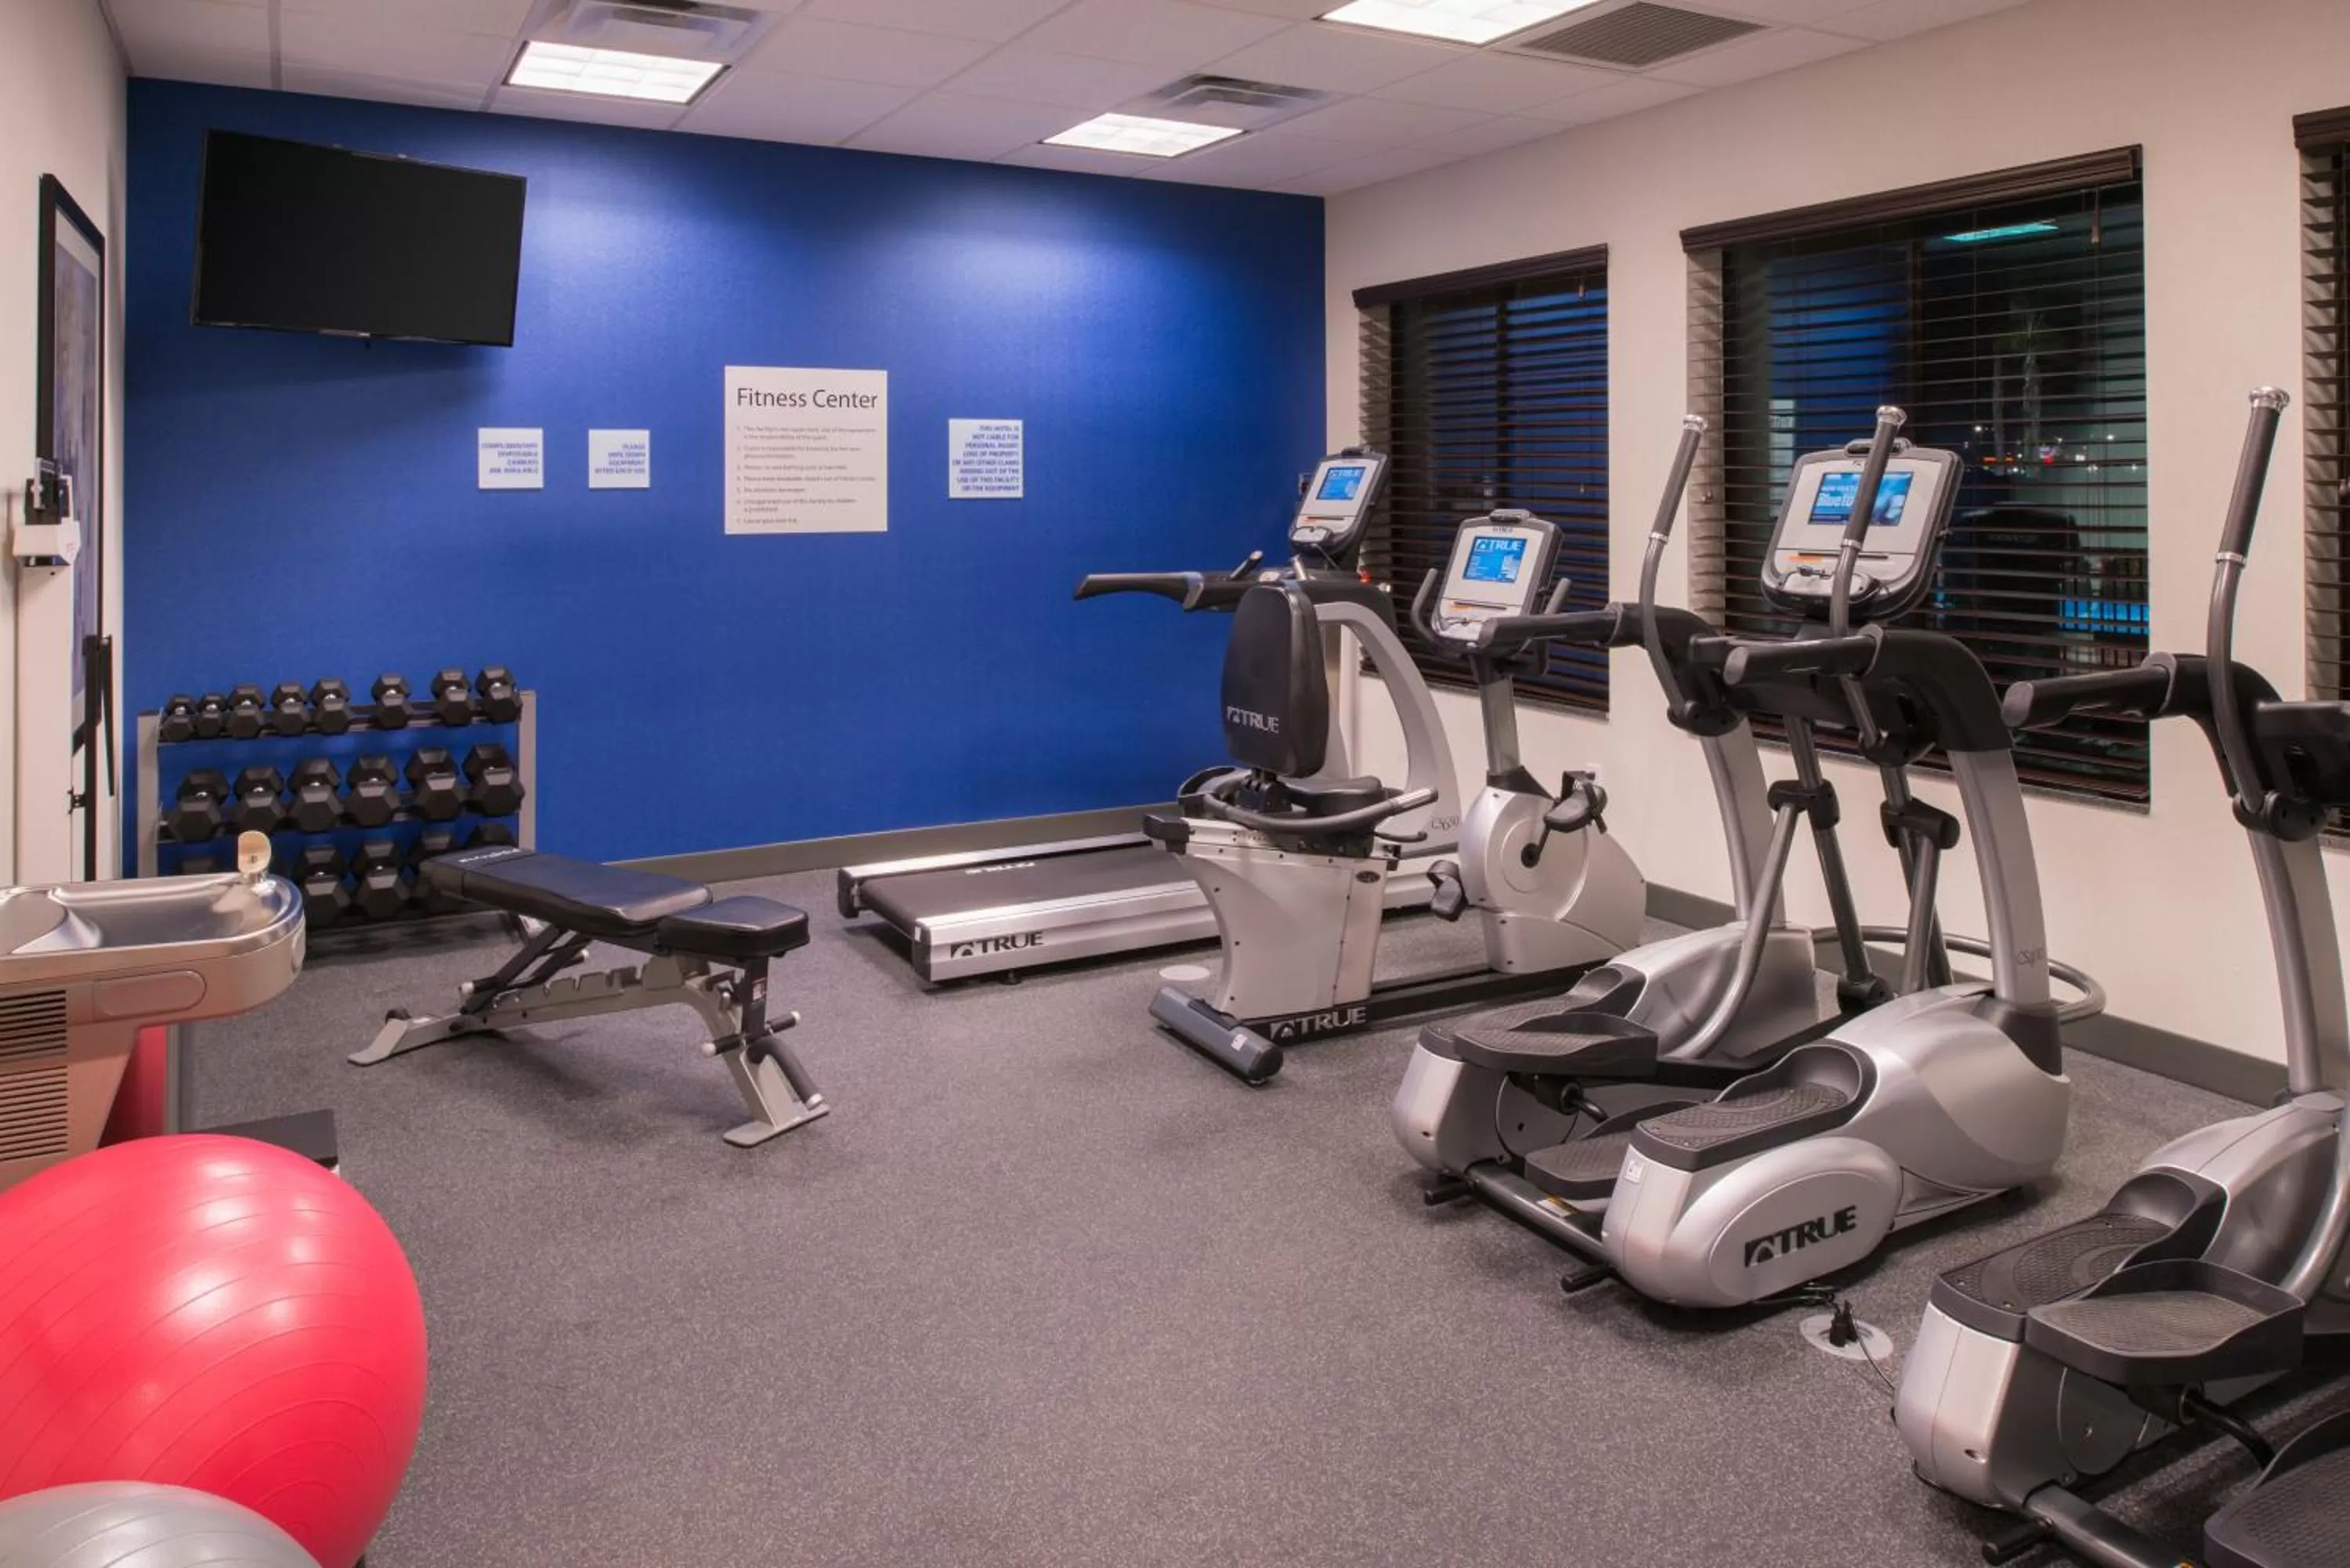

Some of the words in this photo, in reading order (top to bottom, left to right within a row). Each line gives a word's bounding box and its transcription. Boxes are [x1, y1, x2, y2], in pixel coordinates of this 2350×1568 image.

[737, 388, 807, 407] Fitness
[812, 388, 878, 409] Center
[1486, 539, 1524, 551] TRUE
[1240, 709, 1279, 734] TRUE
[976, 930, 1044, 953] TRUE
[1296, 1006, 1367, 1035] TRUE
[1774, 1205, 1857, 1255] TRUE
